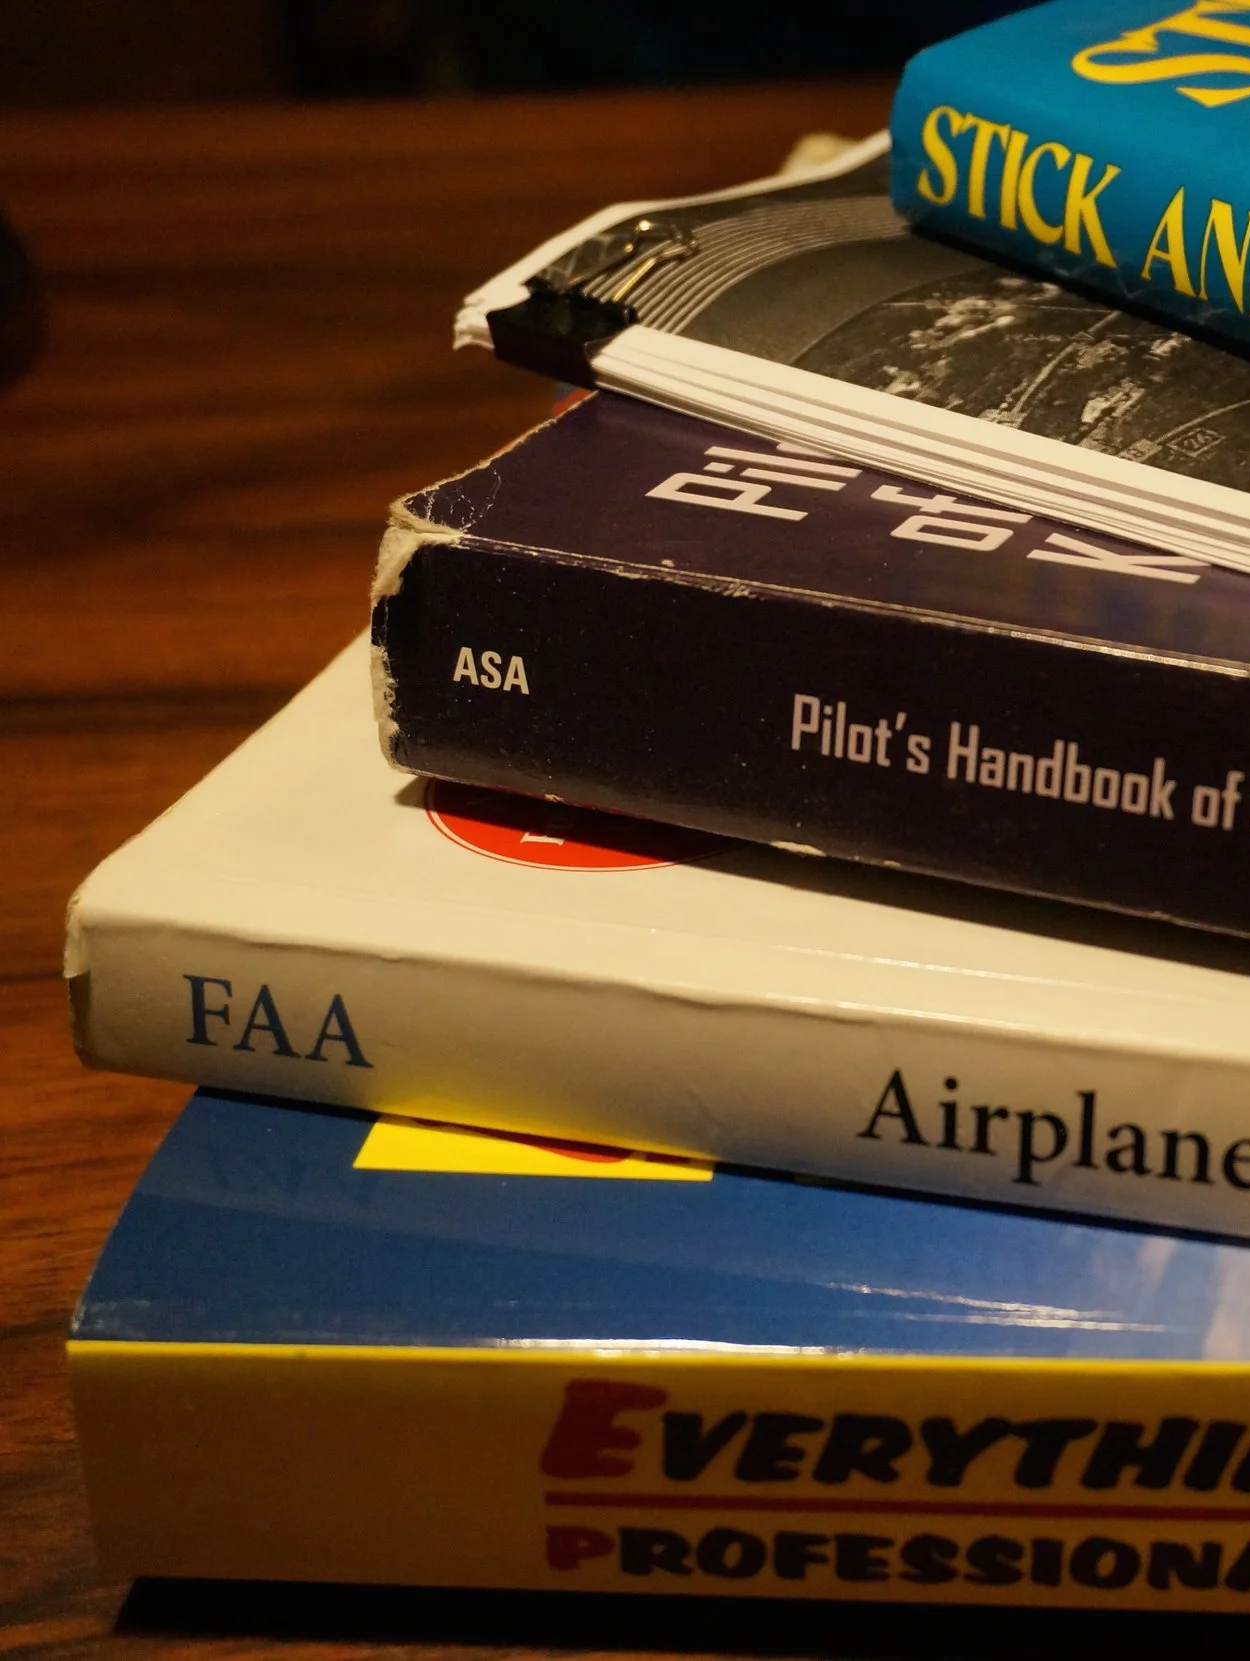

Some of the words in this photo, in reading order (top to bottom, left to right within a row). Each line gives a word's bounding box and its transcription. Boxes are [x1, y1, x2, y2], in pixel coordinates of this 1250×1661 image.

[917, 104, 1121, 270] STICK
[645, 437, 863, 521] Pil
[870, 484, 1033, 551] of
[451, 645, 532, 697] ASA
[790, 692, 932, 778] Pilot's
[946, 721, 1176, 821] Handbook
[1191, 770, 1246, 832] of
[182, 973, 375, 1069] FAA
